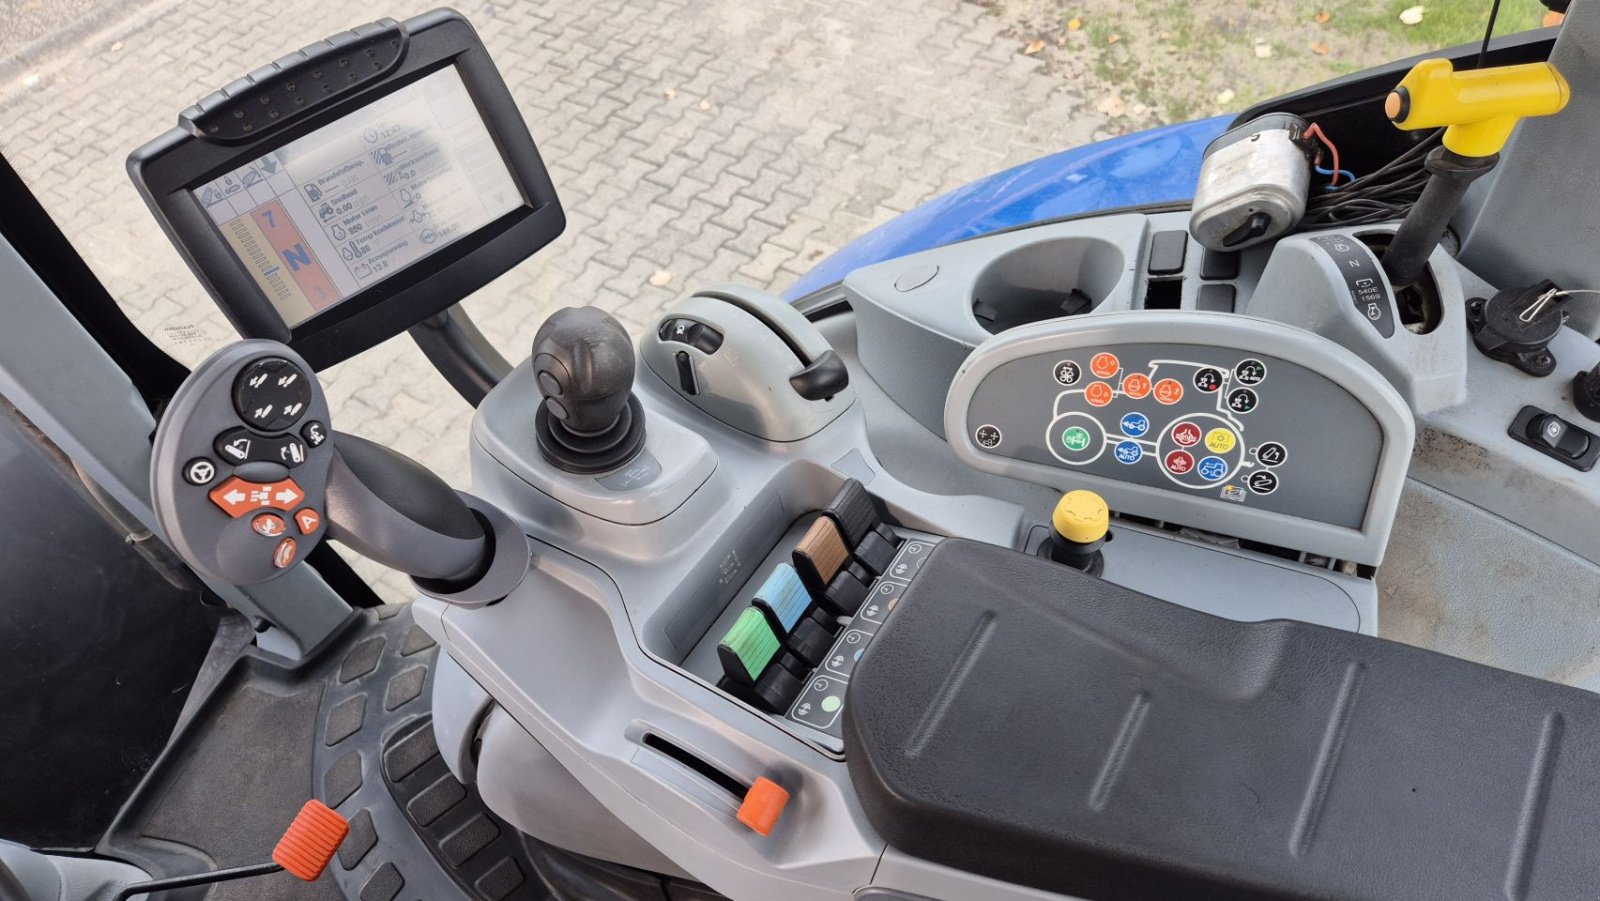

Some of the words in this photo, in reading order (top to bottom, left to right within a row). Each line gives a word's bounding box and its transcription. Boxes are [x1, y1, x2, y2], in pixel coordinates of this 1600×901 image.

[262, 210, 275, 228] 7
[282, 242, 311, 272] N
[1349, 259, 1360, 268] N
[1357, 286, 1378, 295] 540E
[1209, 442, 1229, 450] AUTO
[1118, 453, 1136, 462] AUTO
[1170, 464, 1186, 472] AUTO
[302, 516, 317, 530] A
